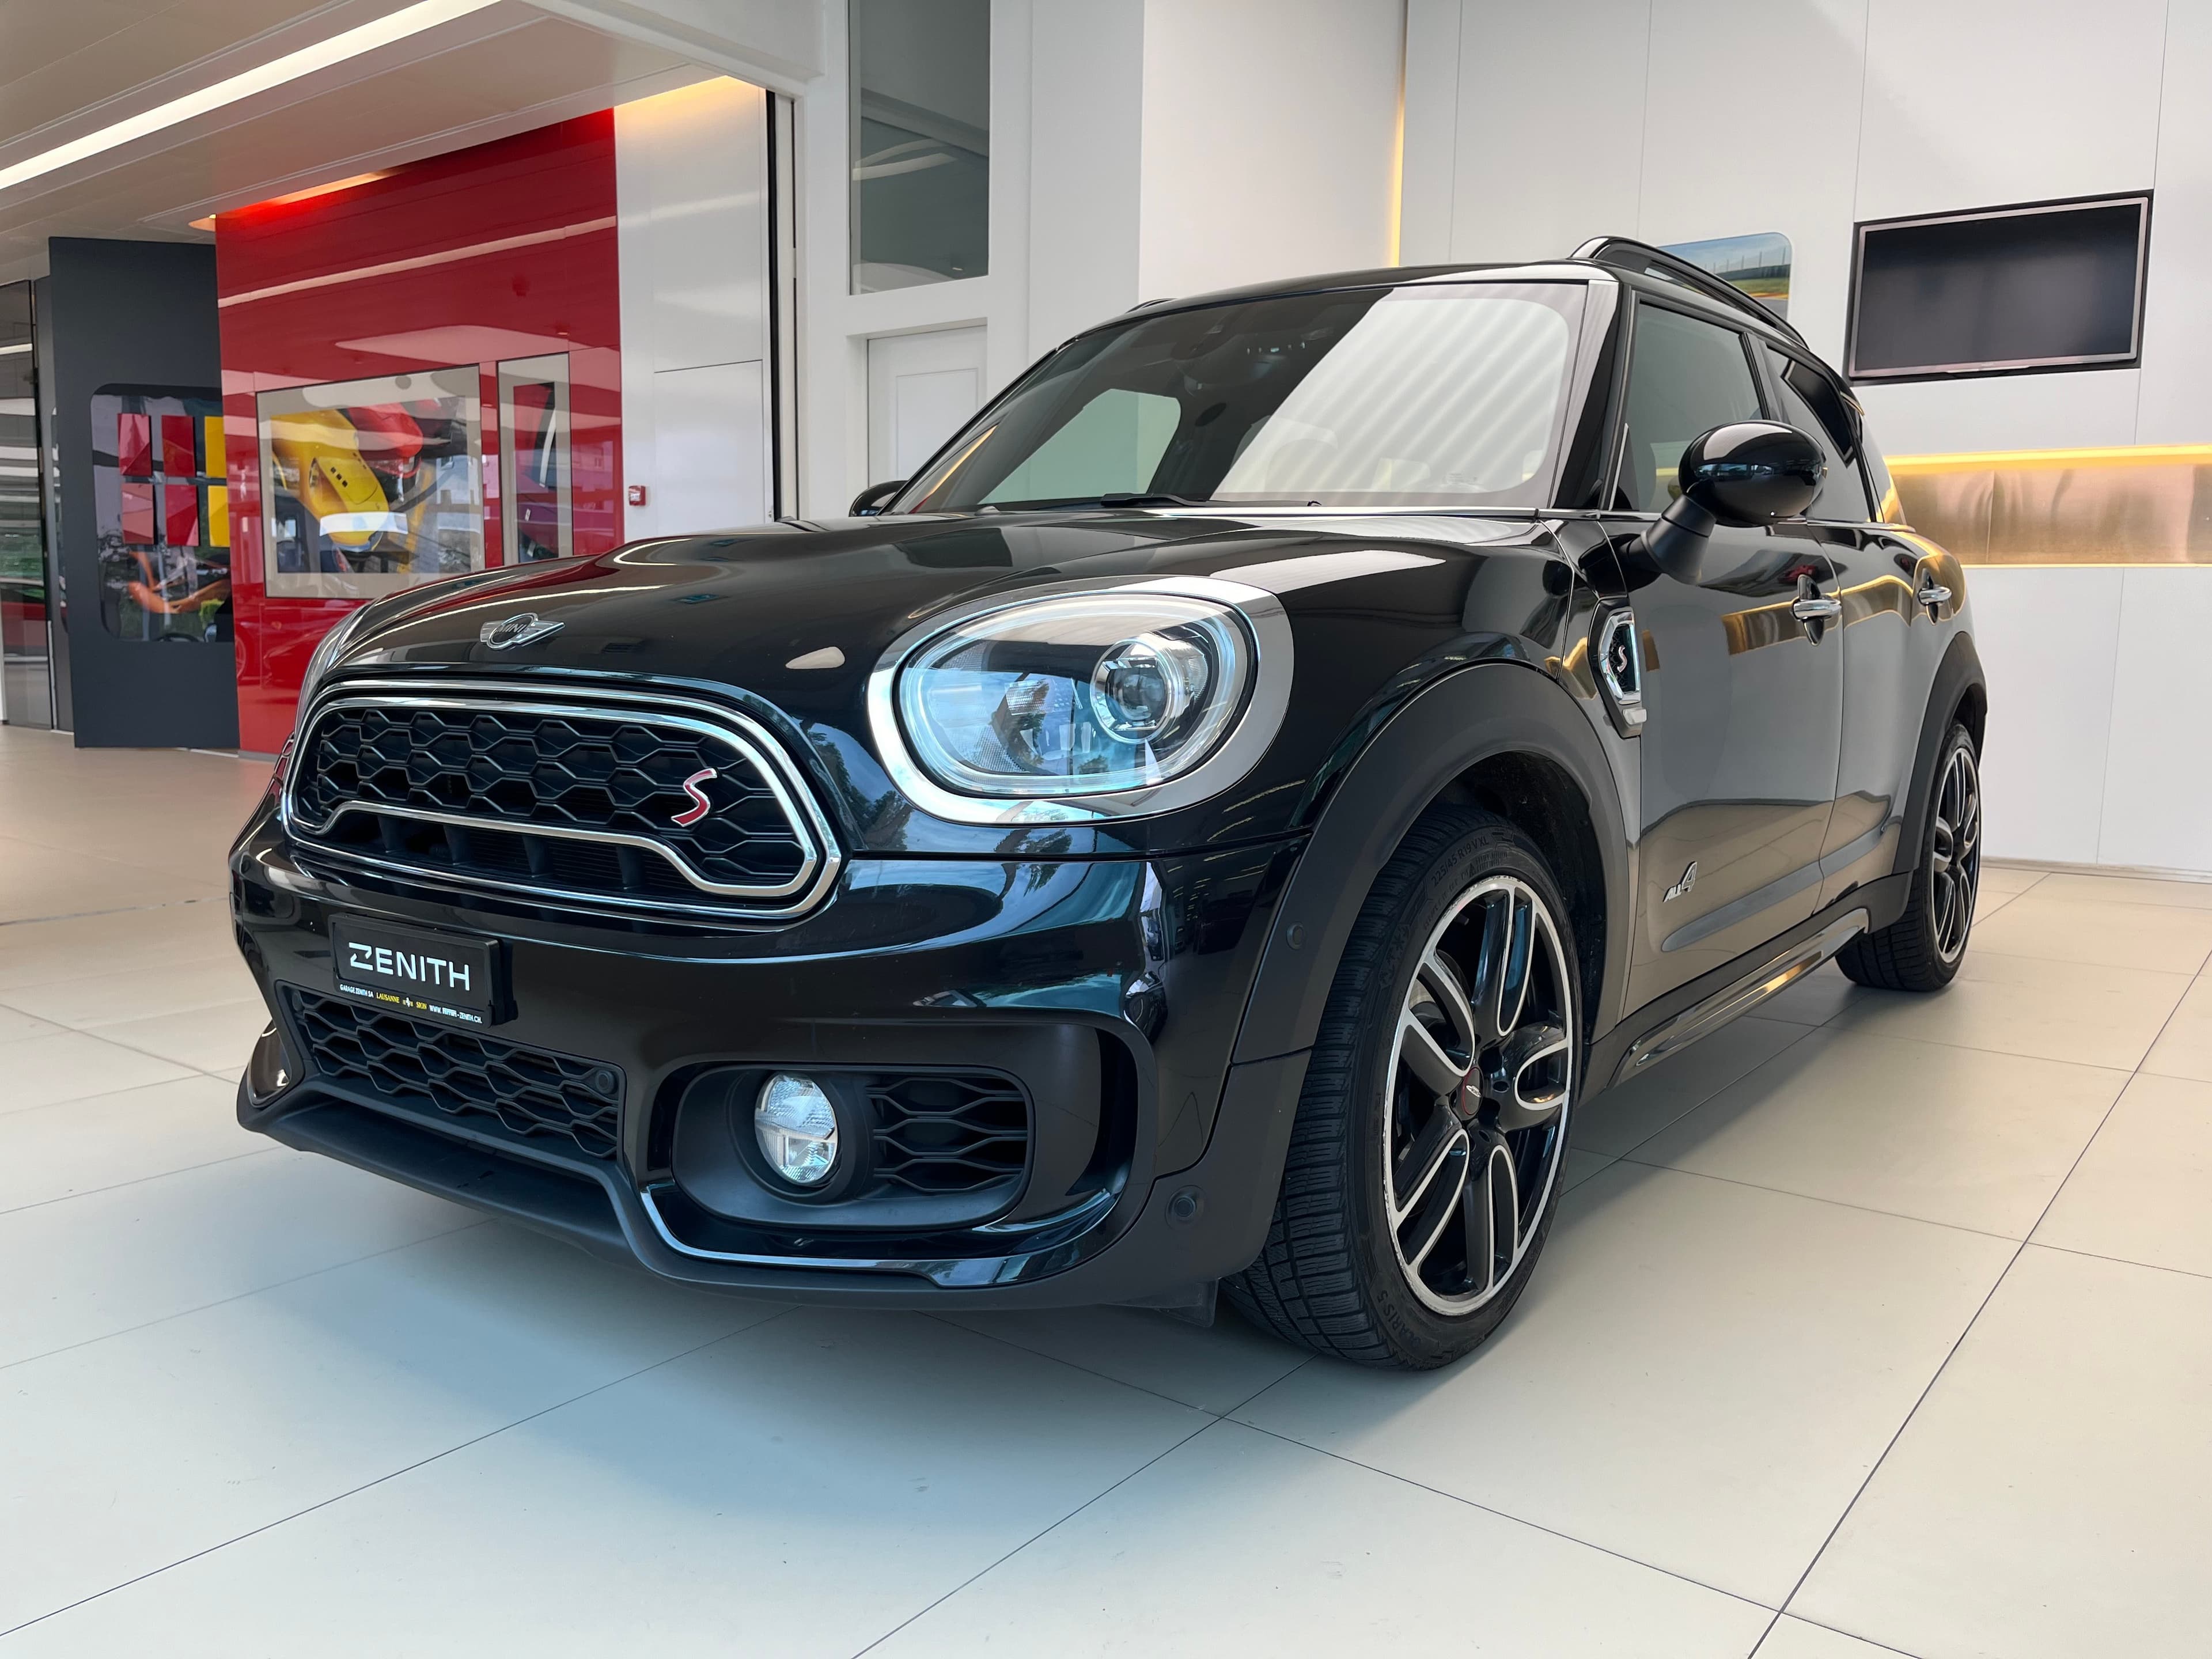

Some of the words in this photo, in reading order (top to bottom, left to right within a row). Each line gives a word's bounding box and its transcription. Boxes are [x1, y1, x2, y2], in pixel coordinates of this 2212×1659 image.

[497, 624, 527, 633] MINI
[1617, 645, 1628, 673] S
[671, 767, 718, 828] S
[1431, 854, 1458, 887] 225/45
[348, 942, 471, 991] ZENITH
[339, 984, 355, 994] GARAGE
[376, 992, 400, 1004] LAUSANNE
[416, 1001, 427, 1010] SION
